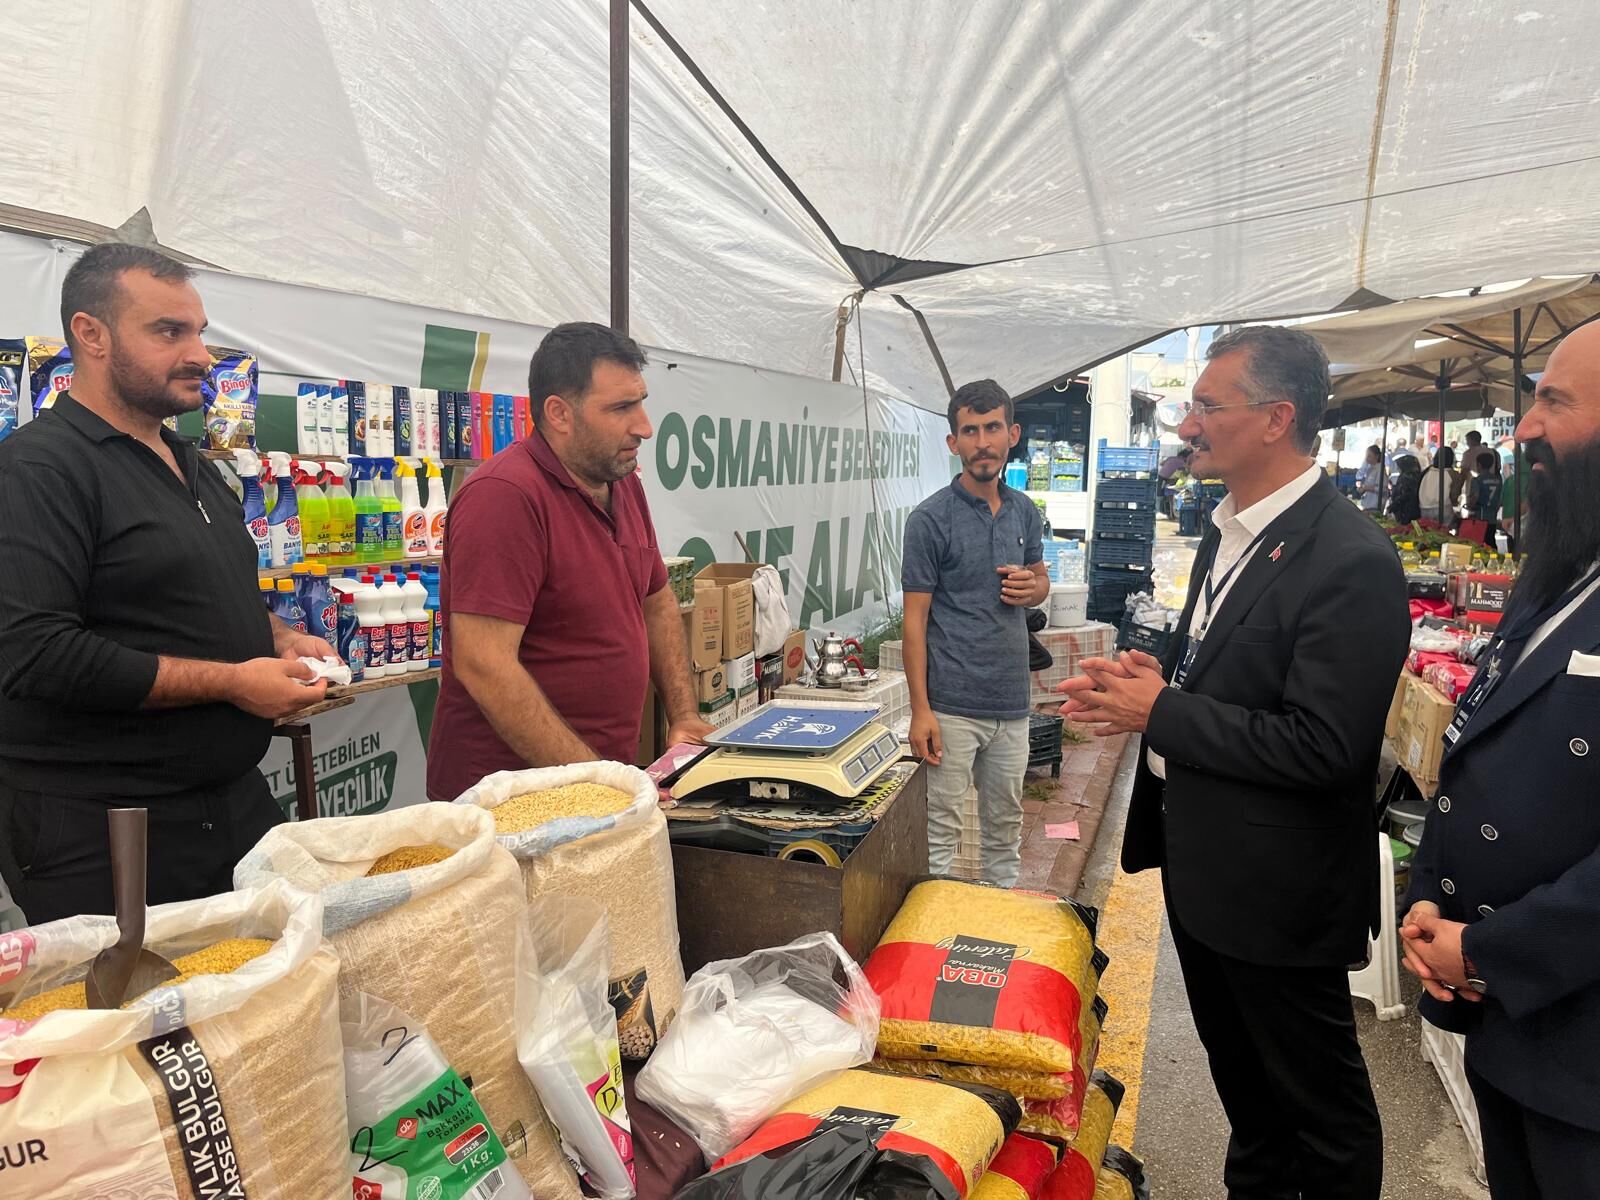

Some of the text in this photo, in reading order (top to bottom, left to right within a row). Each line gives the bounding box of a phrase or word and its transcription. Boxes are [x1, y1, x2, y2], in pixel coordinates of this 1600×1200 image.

[220, 378, 250, 394] Bingo
[656, 405, 920, 491] OSMANİYE BELEDİYESİ
[800, 505, 916, 631] ALAN
[942, 965, 1008, 988] OBA
[152, 1040, 207, 1144] BULGUR
[415, 1080, 464, 1123] MAX
[182, 1040, 245, 1200] ARSE BULGUR
[426, 1101, 474, 1138] Bakkaliye
[0, 1138, 49, 1172] UR
